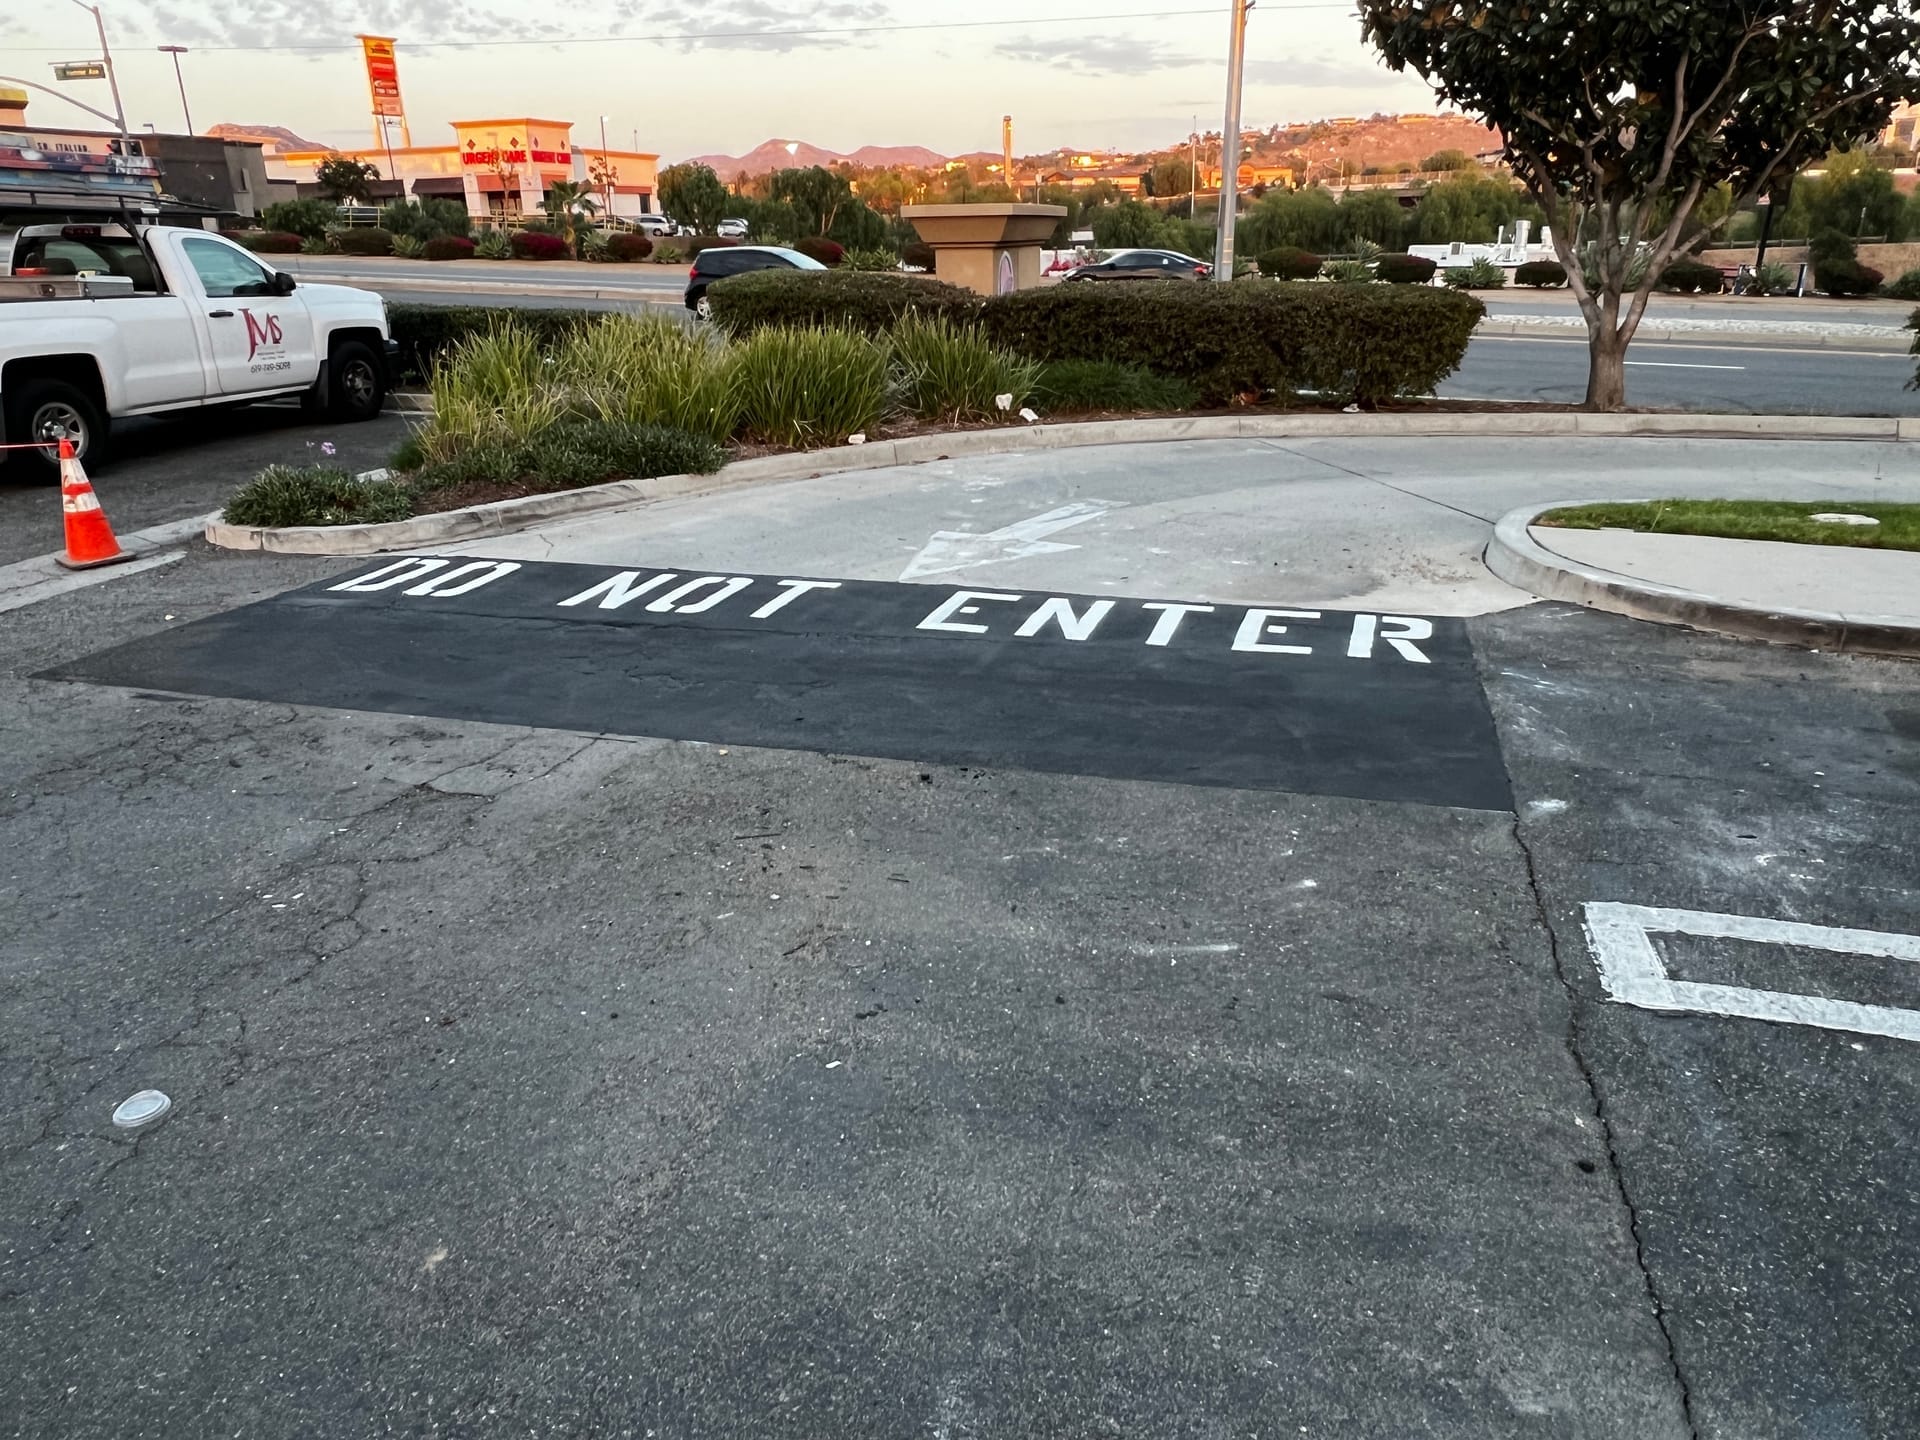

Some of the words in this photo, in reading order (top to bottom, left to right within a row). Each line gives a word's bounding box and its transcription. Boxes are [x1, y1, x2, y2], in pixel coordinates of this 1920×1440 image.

[502, 150, 527, 164] CARE
[326, 557, 522, 597] DO
[557, 571, 842, 619] NOT
[915, 591, 1433, 664] ENTER
